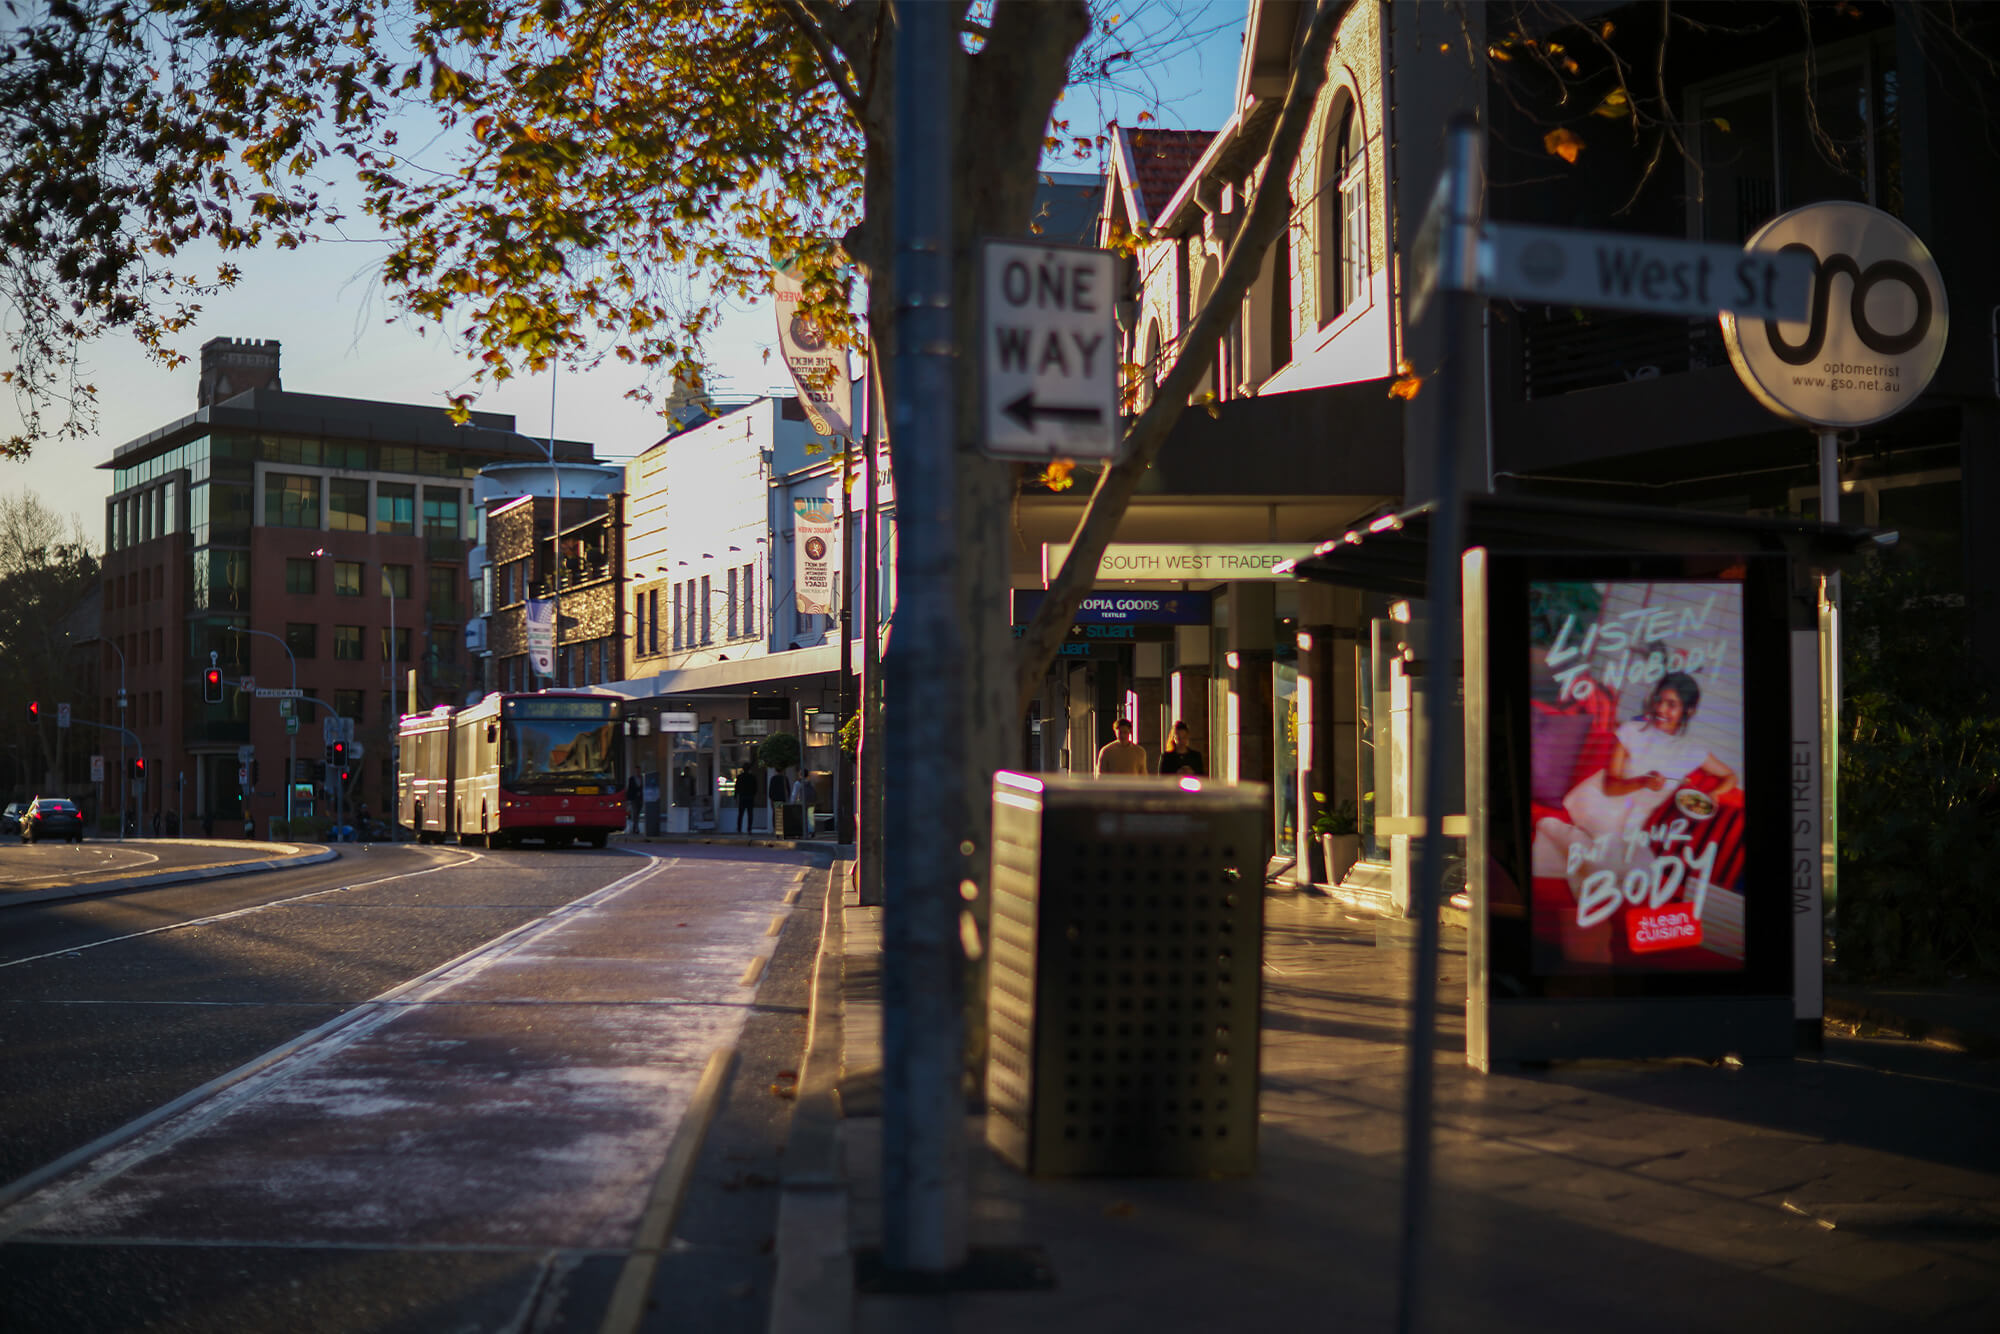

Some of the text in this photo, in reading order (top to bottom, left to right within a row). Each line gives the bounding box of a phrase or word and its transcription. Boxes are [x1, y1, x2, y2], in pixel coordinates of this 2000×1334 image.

[1595, 245, 1777, 309] West St
[1003, 261, 1096, 313] ONE
[996, 326, 1105, 379] WAY
[1823, 363, 1900, 377] optometrist
[1791, 376, 1900, 392] www.gso.net.au
[1103, 556, 1160, 569] SOUTH
[1166, 556, 1211, 569] WEST
[1116, 599, 1159, 610] GOODS
[1086, 624, 1135, 638] stuart
[1545, 594, 1714, 667] LISTEN
[1792, 740, 1812, 914] WEST STREET
[1636, 924, 1696, 942] cuisine
